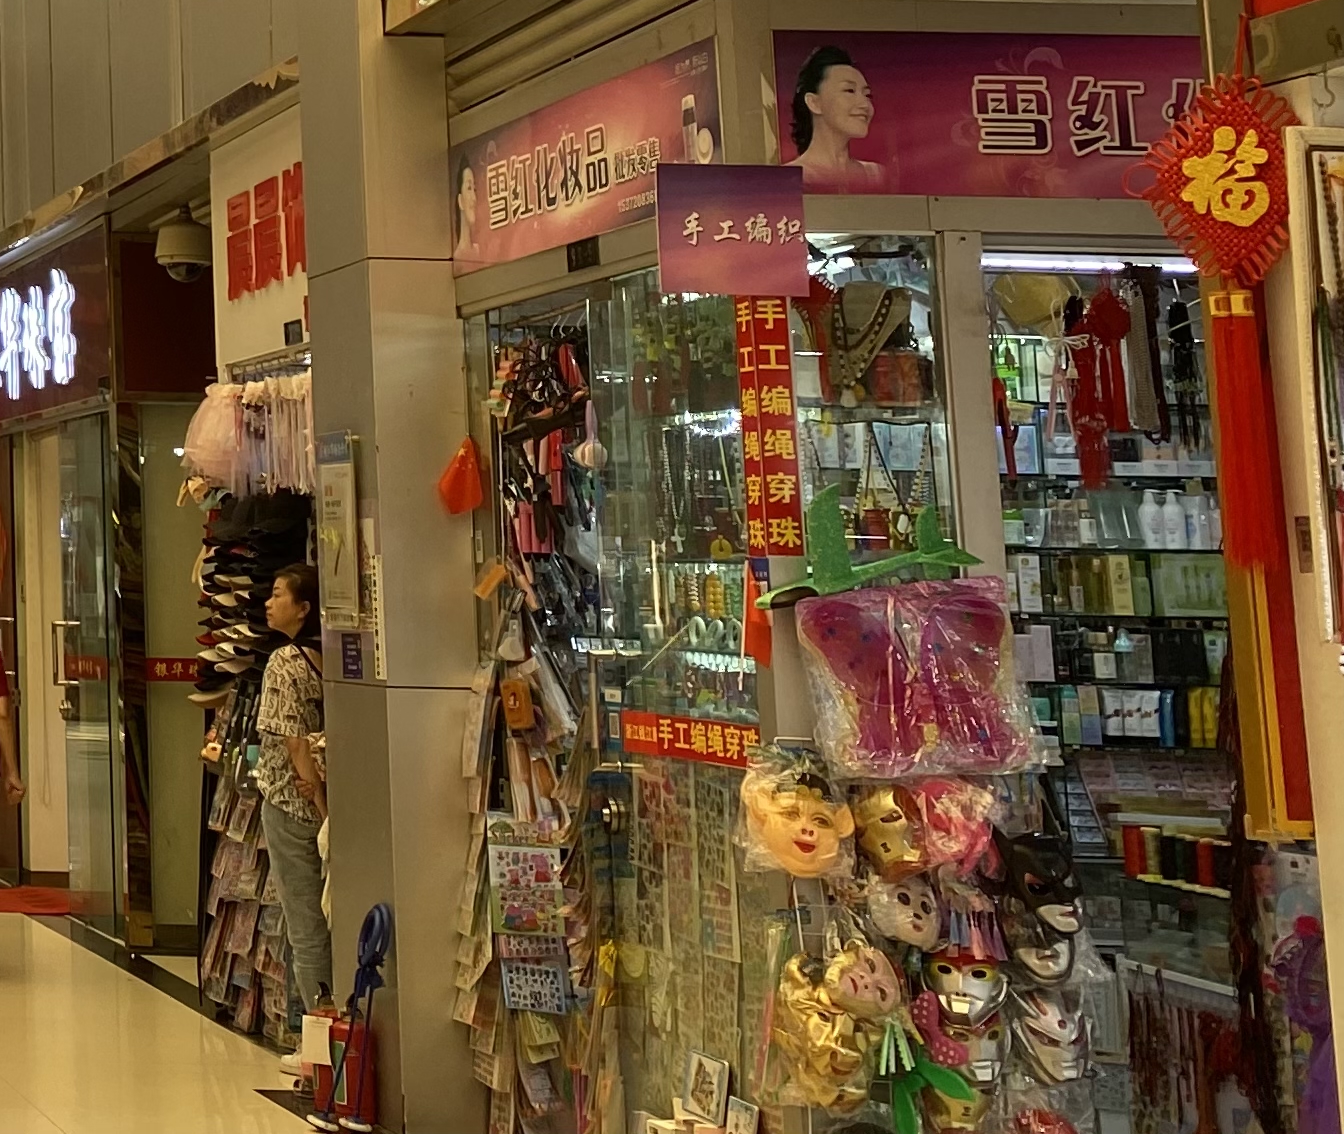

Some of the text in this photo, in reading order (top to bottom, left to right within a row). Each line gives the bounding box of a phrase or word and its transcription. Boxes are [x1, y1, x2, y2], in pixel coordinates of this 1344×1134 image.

[486, 122, 610, 230] 雪红化妆品
[681, 211, 808, 247] 手工编织
[1181, 125, 1271, 228] 福
[736, 300, 765, 550] 手工编绳穿珠
[754, 299, 802, 548] 手工编绳穿珠
